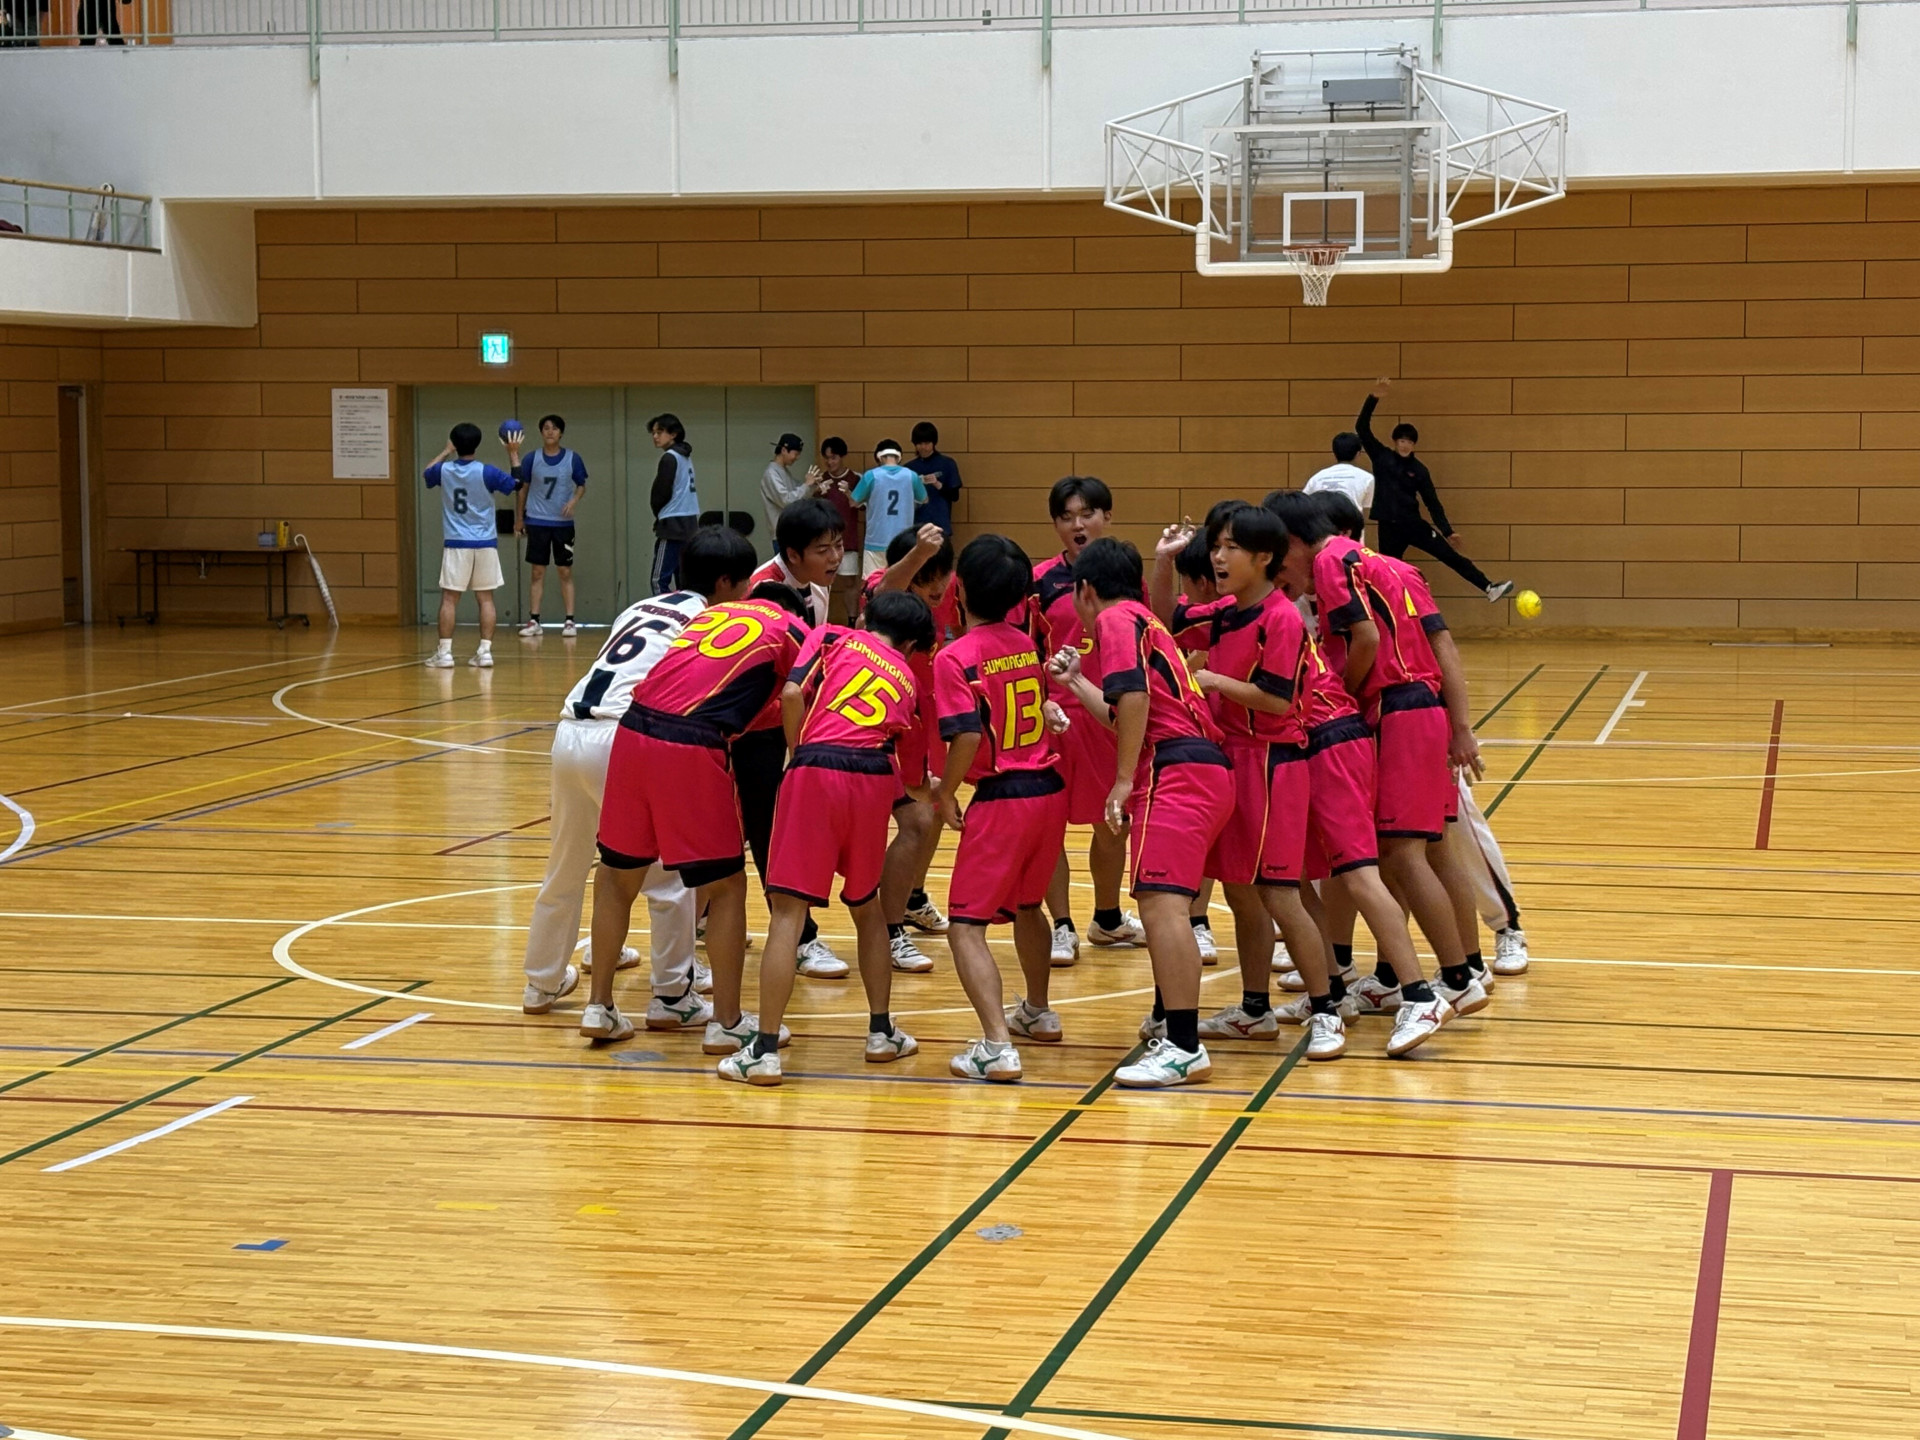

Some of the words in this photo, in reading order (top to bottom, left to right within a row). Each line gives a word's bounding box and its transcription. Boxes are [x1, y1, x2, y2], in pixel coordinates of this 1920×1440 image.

[1322, 80, 1329, 89] D
[453, 487, 468, 515] 6
[543, 476, 557, 500] 7
[887, 489, 899, 516] 2
[597, 615, 651, 665] 16
[669, 611, 764, 659] 20
[844, 638, 915, 698] SUMIDAGAWA
[825, 665, 902, 728] 15
[1001, 676, 1044, 751] 13
